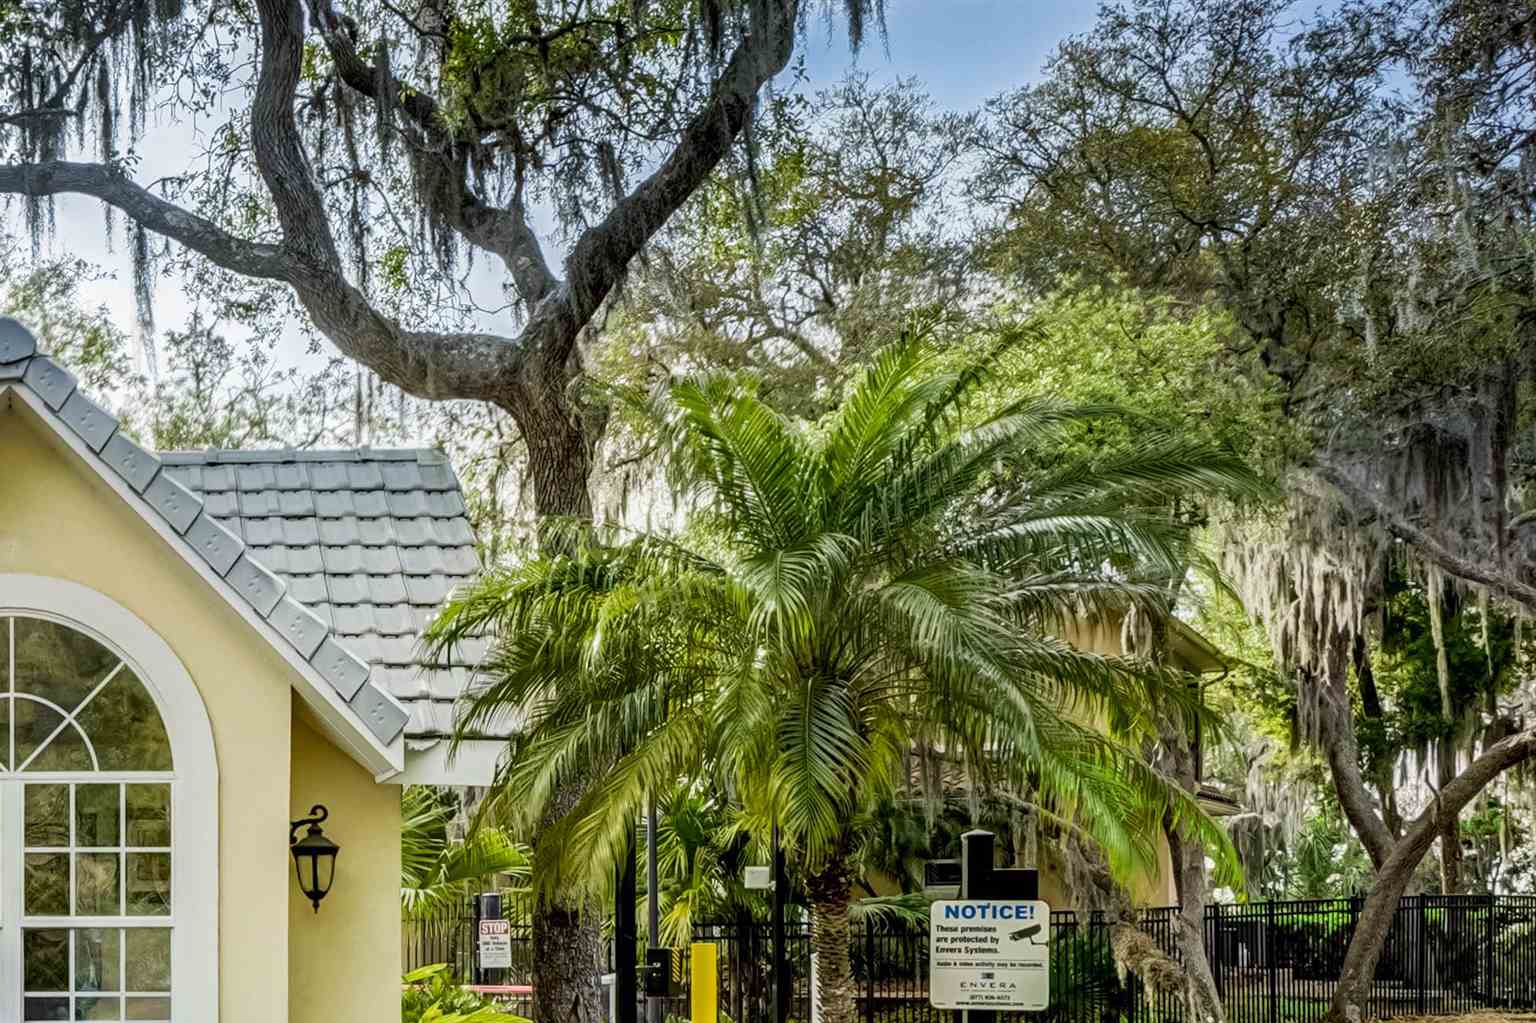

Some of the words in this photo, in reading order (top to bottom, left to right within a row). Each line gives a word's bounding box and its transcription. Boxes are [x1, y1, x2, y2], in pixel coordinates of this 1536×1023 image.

[945, 905, 1035, 919] NOTICE!
[481, 922, 508, 934] STOP
[960, 925, 997, 934] premises
[950, 936, 988, 944] protected
[990, 936, 1000, 945] by
[964, 946, 1000, 955] Systems.
